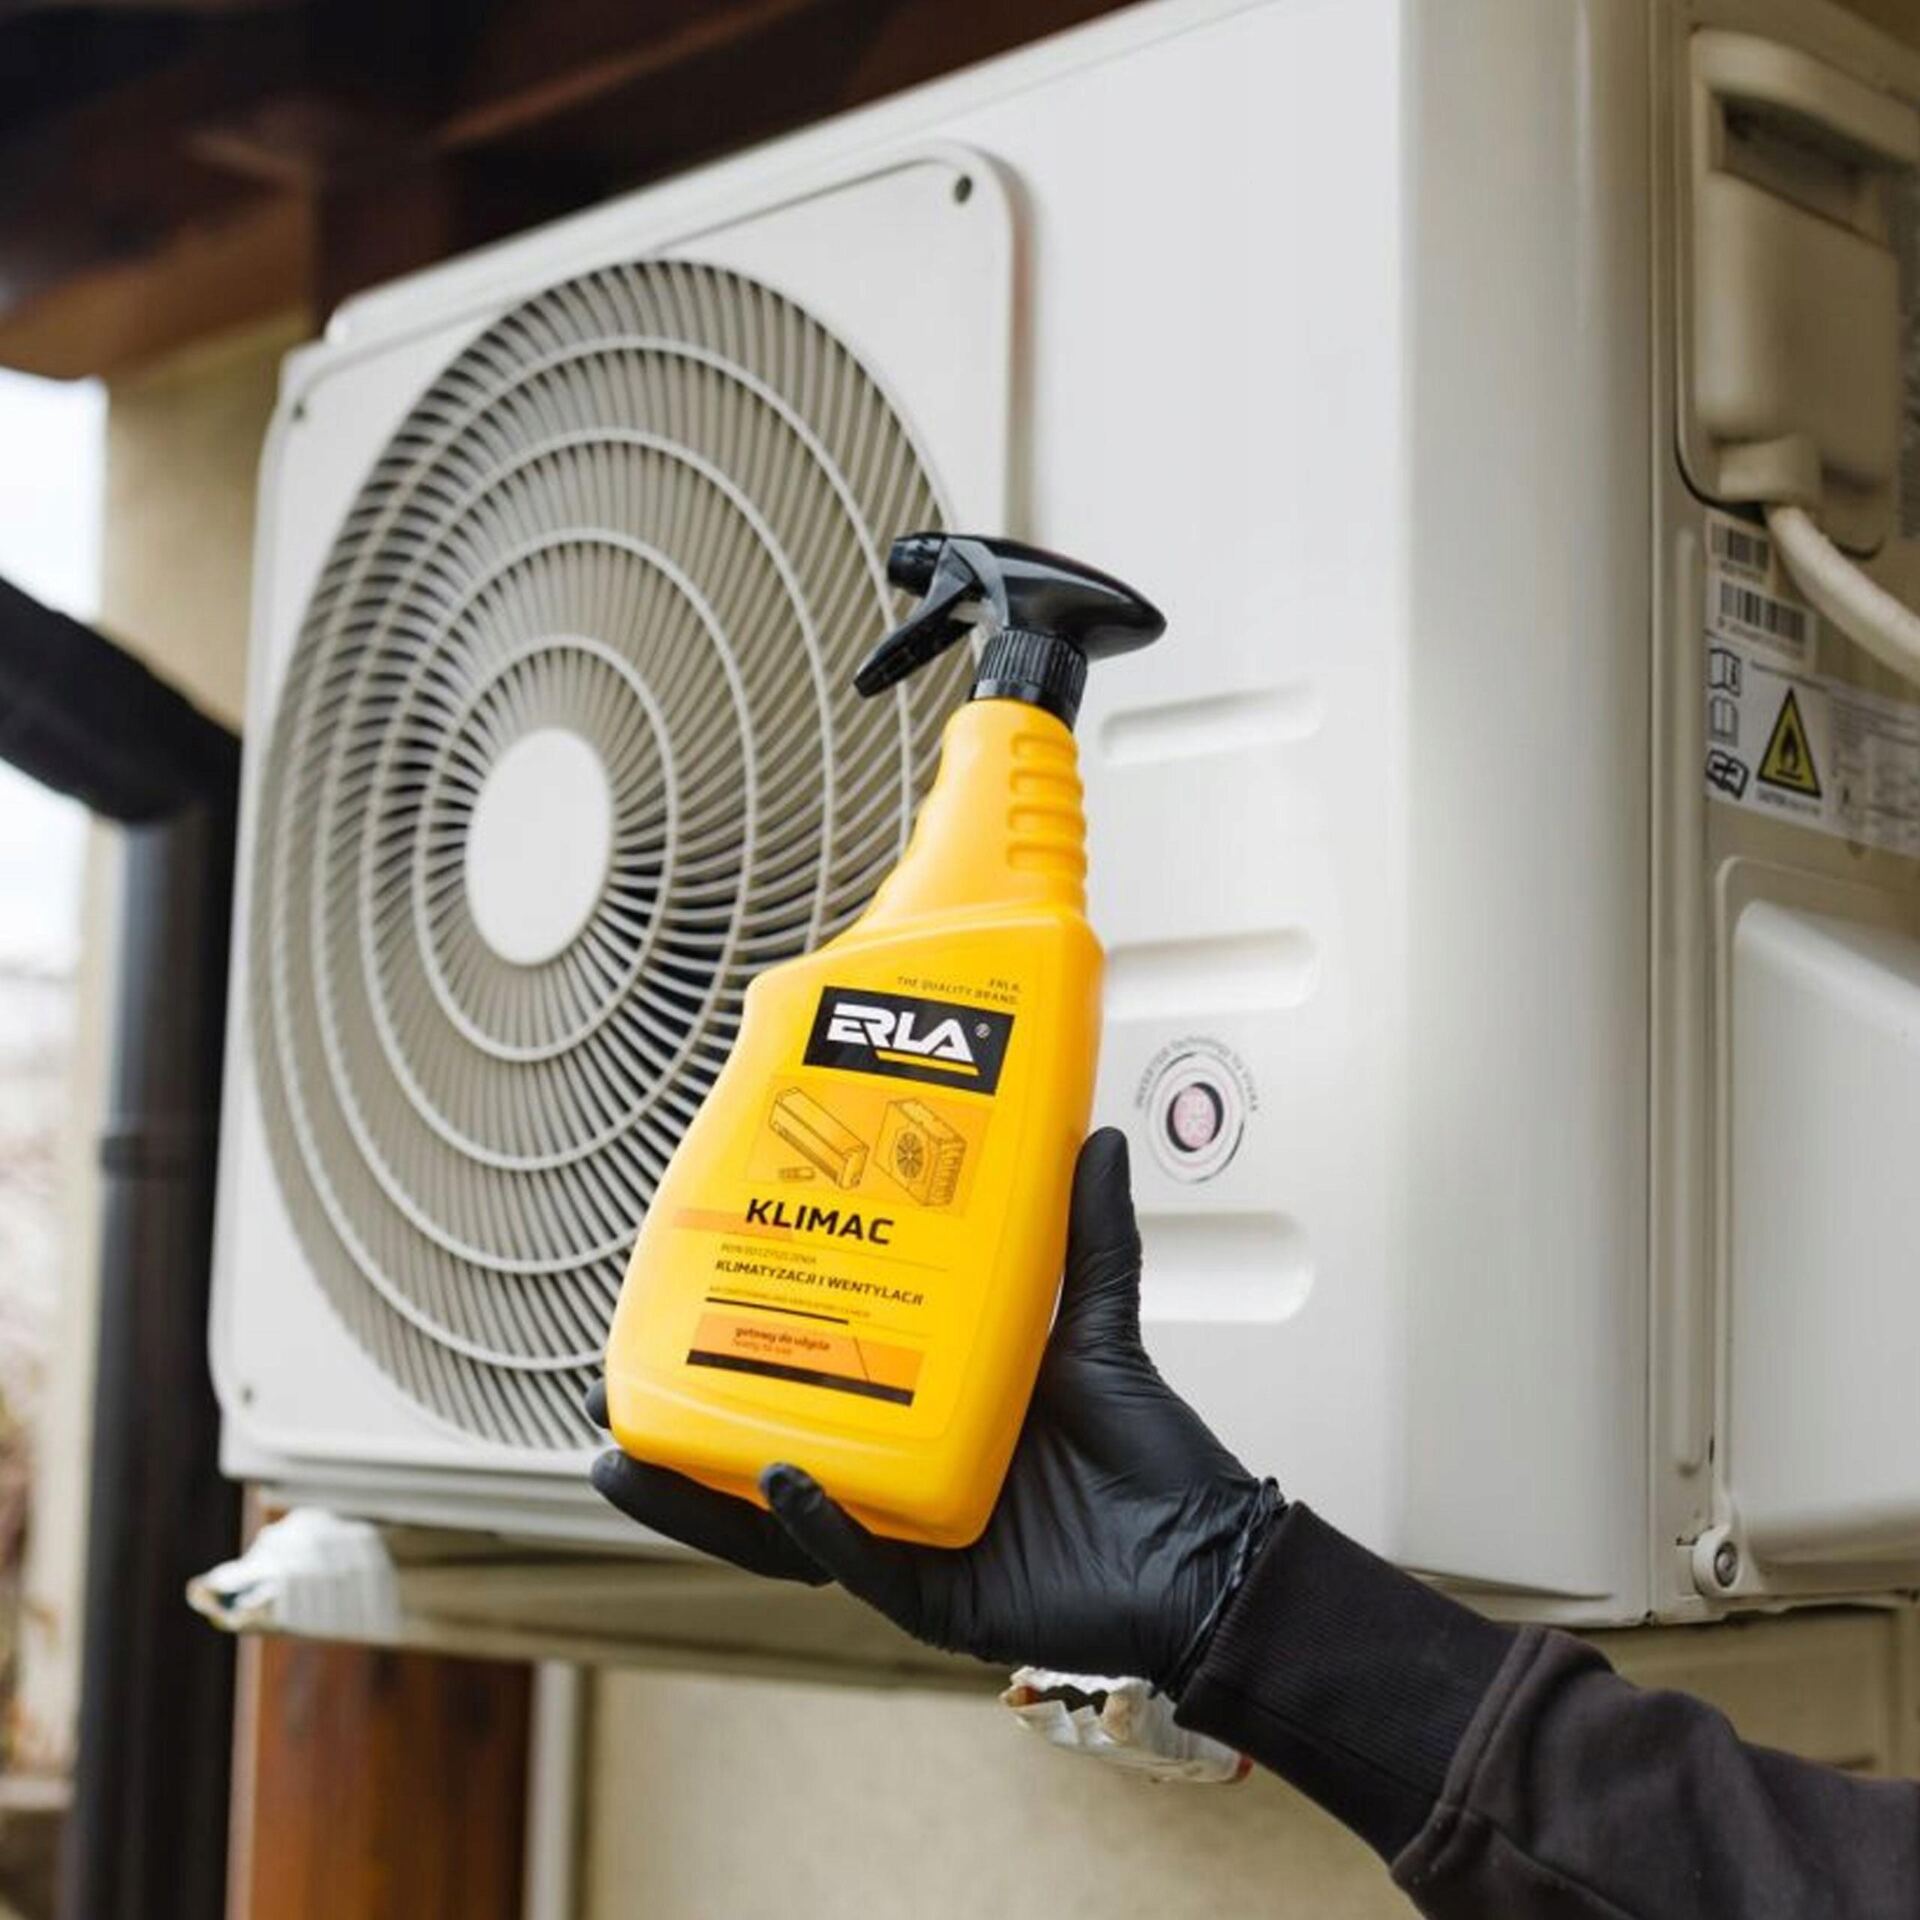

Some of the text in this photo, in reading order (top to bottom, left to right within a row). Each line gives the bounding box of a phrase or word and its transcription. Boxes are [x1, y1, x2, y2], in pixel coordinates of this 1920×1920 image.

[826, 1002, 974, 1063] ERLA
[746, 1198, 894, 1245] KLIMAC
[715, 1259, 816, 1286] KLIMATYZACJI
[827, 1276, 924, 1306] WENTYLACJI
